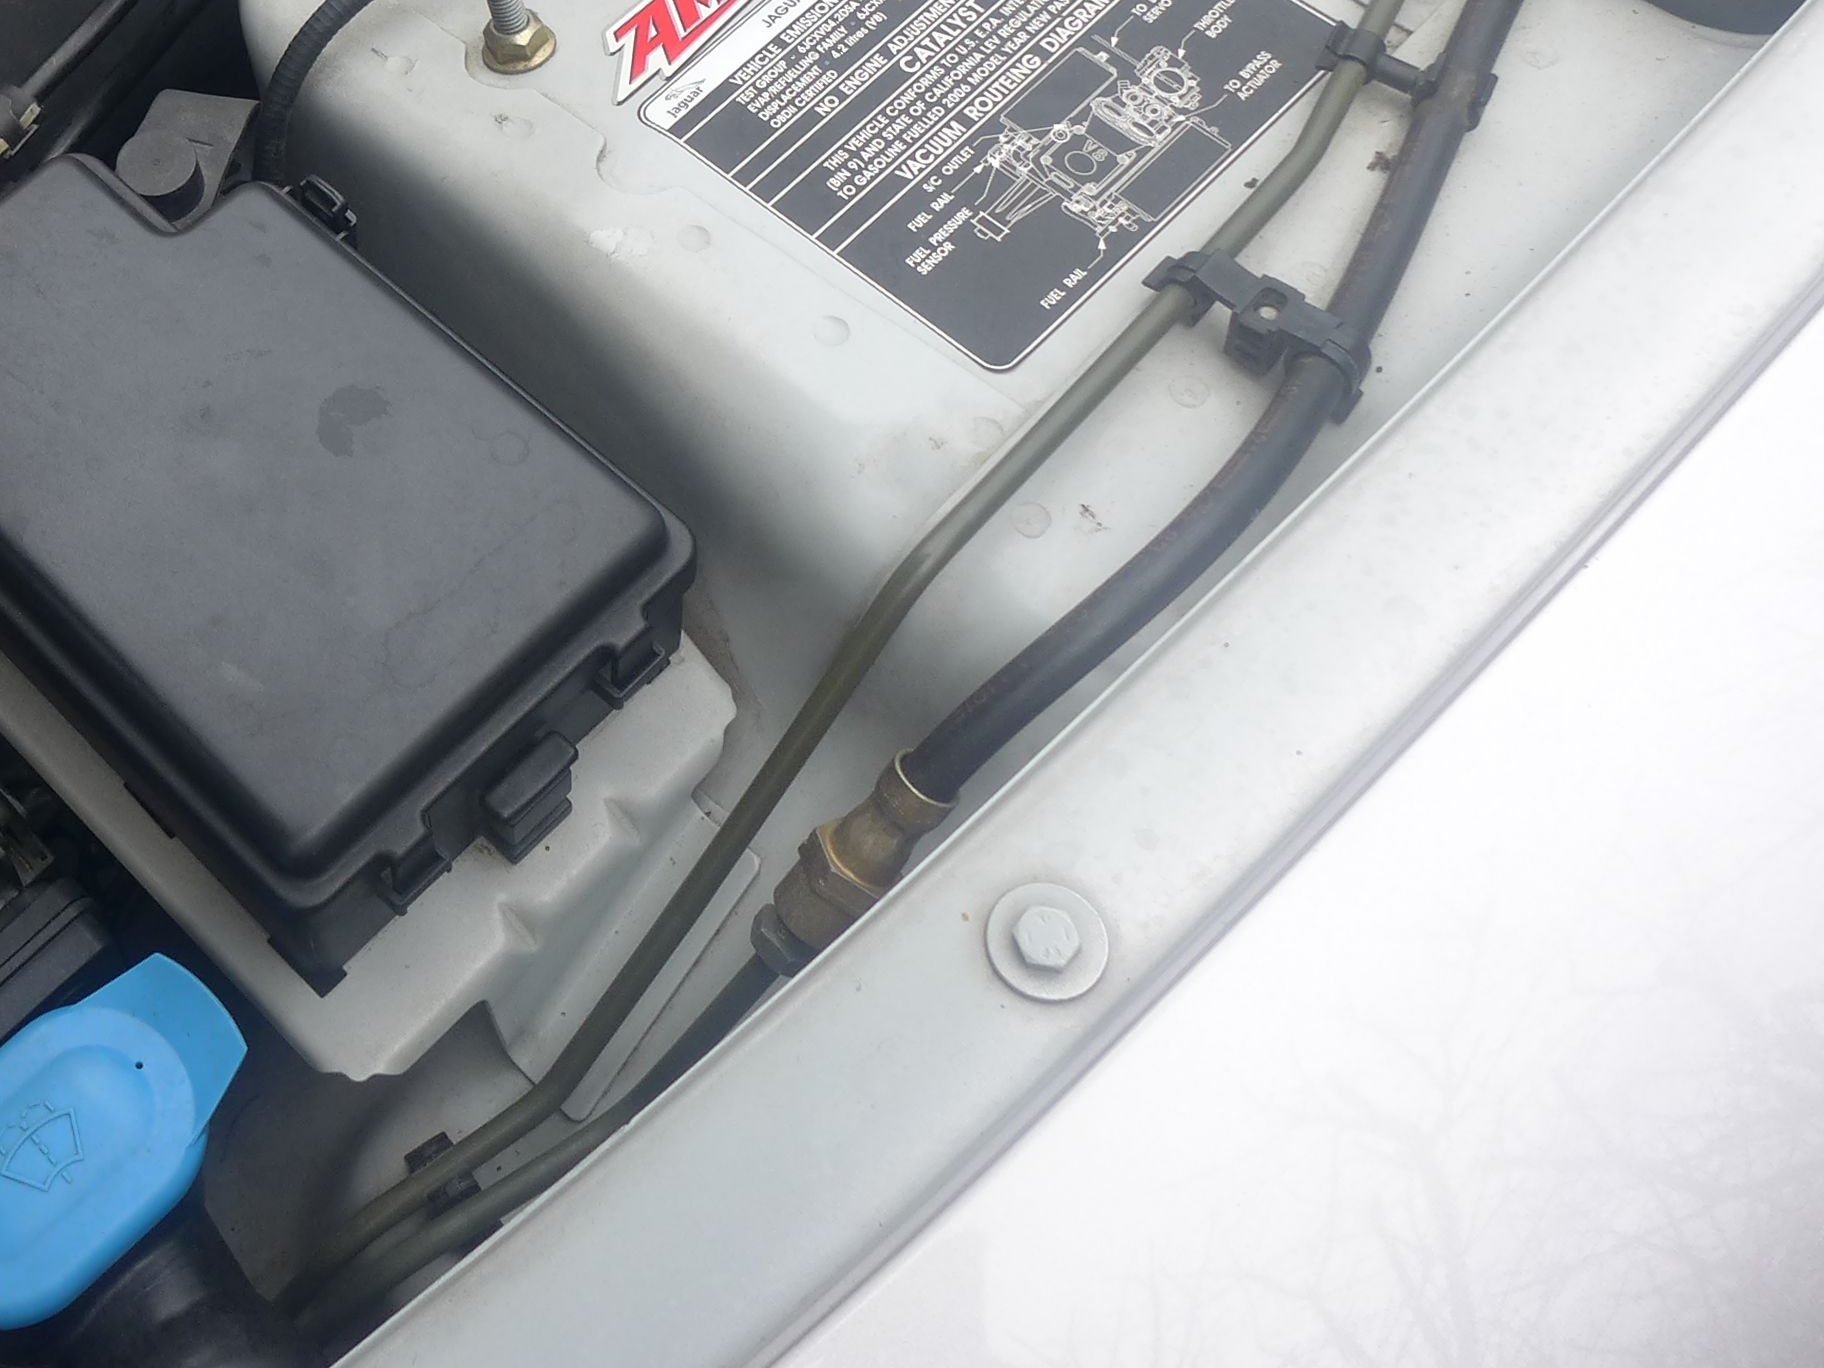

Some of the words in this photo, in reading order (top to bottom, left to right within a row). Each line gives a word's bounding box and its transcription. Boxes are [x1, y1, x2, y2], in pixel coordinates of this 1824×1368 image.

[1130, 2, 1149, 17] TO
[1204, 14, 1234, 38] BODY
[728, 42, 782, 87] VEHICLE
[735, 86, 759, 105] TEST
[753, 60, 790, 89] GROUP
[745, 49, 822, 113] EVAP/REFUELLING
[815, 25, 850, 53] FAMILY
[756, 64, 825, 121] DISPLACEMENT
[828, 42, 850, 60] 4.2
[843, 25, 870, 47] litres
[862, 10, 889, 30] (V8)
[812, 93, 842, 117] NO
[837, 53, 889, 95] ENGINE
[1223, 77, 1242, 92] TO
[1238, 50, 1273, 79] BYPASS
[1234, 58, 1283, 100] ACTUATOR
[665, 85, 706, 118] Jaguar
[792, 68, 840, 107] CERTIFIED
[822, 148, 850, 171] THIS
[843, 113, 890, 152] VEHICLE
[883, 64, 946, 118] CONFORMS
[939, 52, 961, 68] TO
[954, 35, 980, 55] U.S.
[972, 13, 1005, 39] E.P.A.
[836, 183, 858, 201] TO
[851, 139, 908, 187] GASOLINE
[900, 104, 947, 144] FUELLED
[940, 81, 973, 109] 2006
[965, 51, 1007, 86] MODEL
[1000, 30, 1031, 55] YEAR
[1024, 10, 1054, 34] NEW
[823, 167, 854, 192] (BIN
[845, 156, 866, 173] 9)
[856, 137, 887, 161] AND
[880, 113, 914, 141] STATE
[907, 100, 929, 117] OF
[921, 49, 986, 104] CALIFORNIA
[977, 34, 1003, 54] LEV
[893, 119, 968, 182] VACUUM
[961, 51, 1046, 122] ROUTEING
[920, 174, 944, 194] S/C
[939, 145, 976, 176] OUTLET
[906, 209, 933, 232] FUEL
[929, 190, 955, 211] RAIL
[903, 244, 931, 267] FUEL
[927, 206, 974, 246] PRESSURE
[915, 240, 956, 275] SENSOR
[1038, 286, 1066, 309] FUEL
[1062, 266, 1088, 288] RAIL
